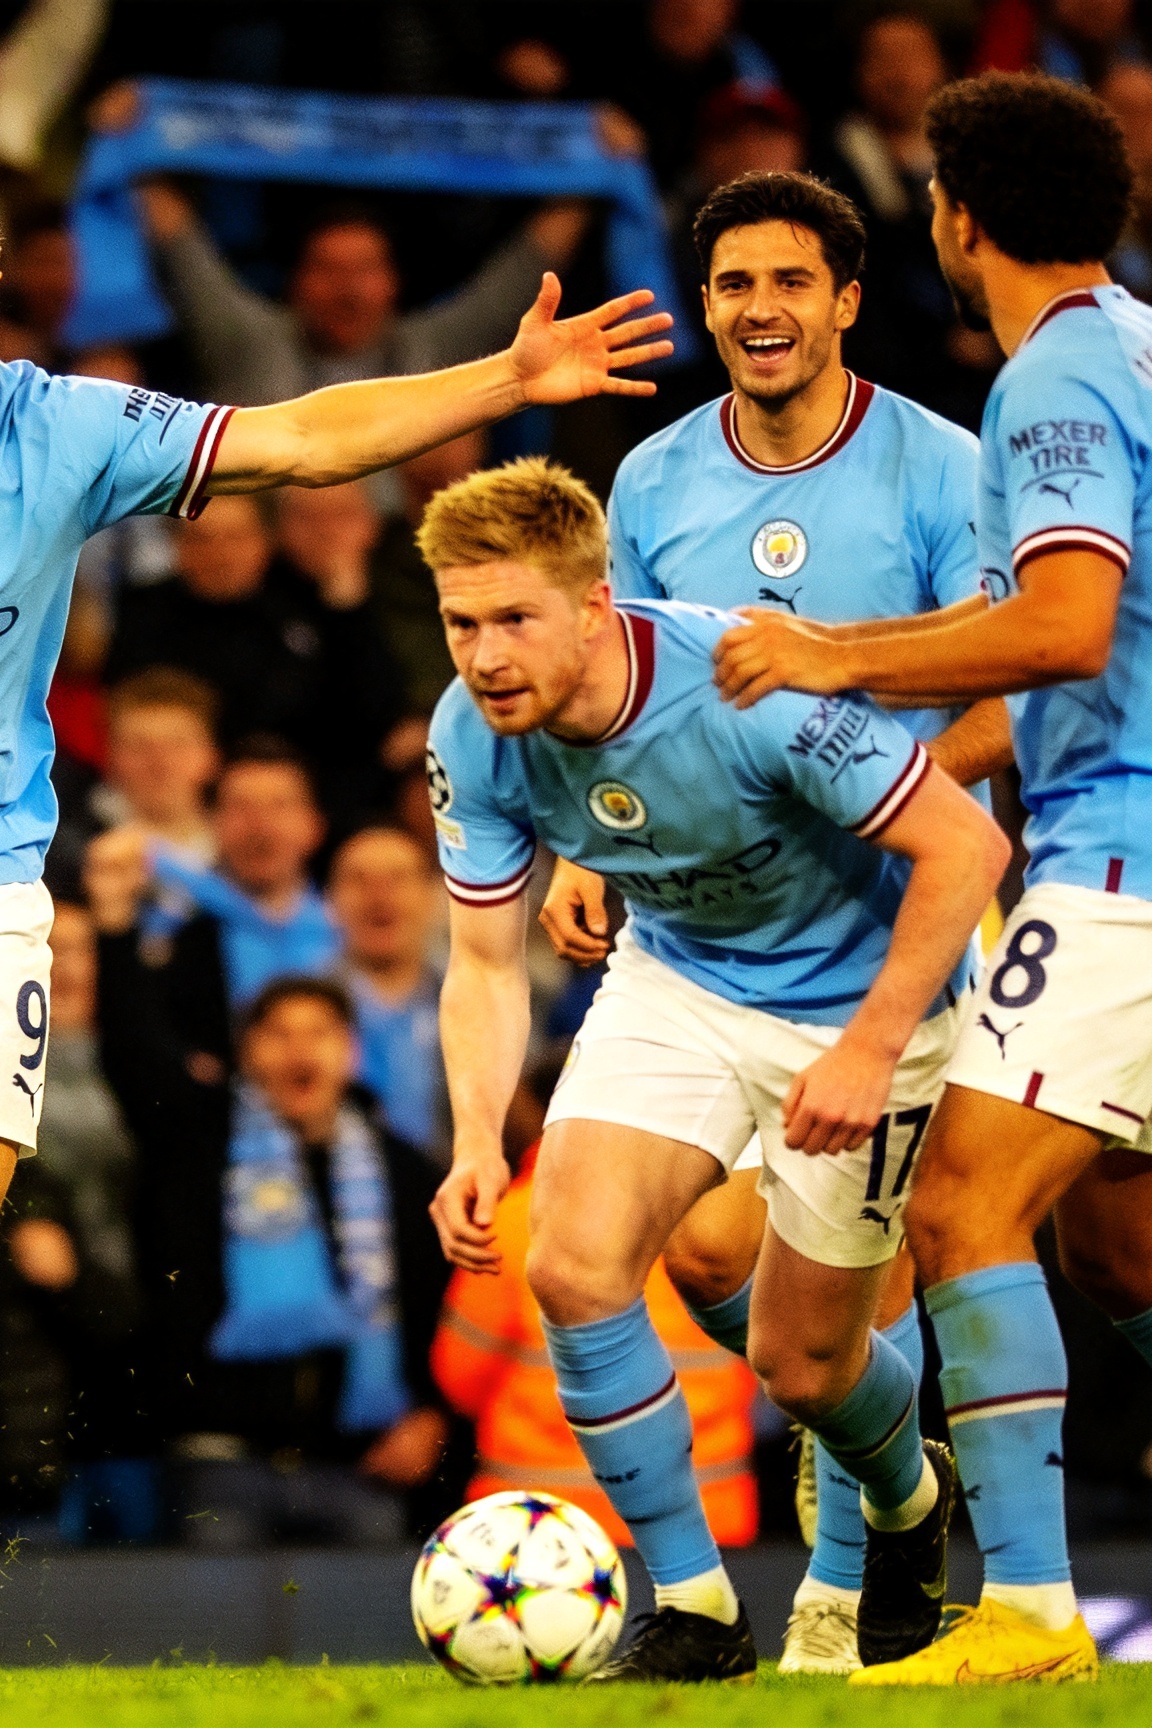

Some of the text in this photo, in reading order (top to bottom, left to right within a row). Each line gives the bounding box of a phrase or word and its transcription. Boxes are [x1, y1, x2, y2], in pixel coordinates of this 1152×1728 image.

[989, 919, 1057, 1009] 8
[16, 980, 48, 1071] 9
[865, 1102, 934, 1201] 17
